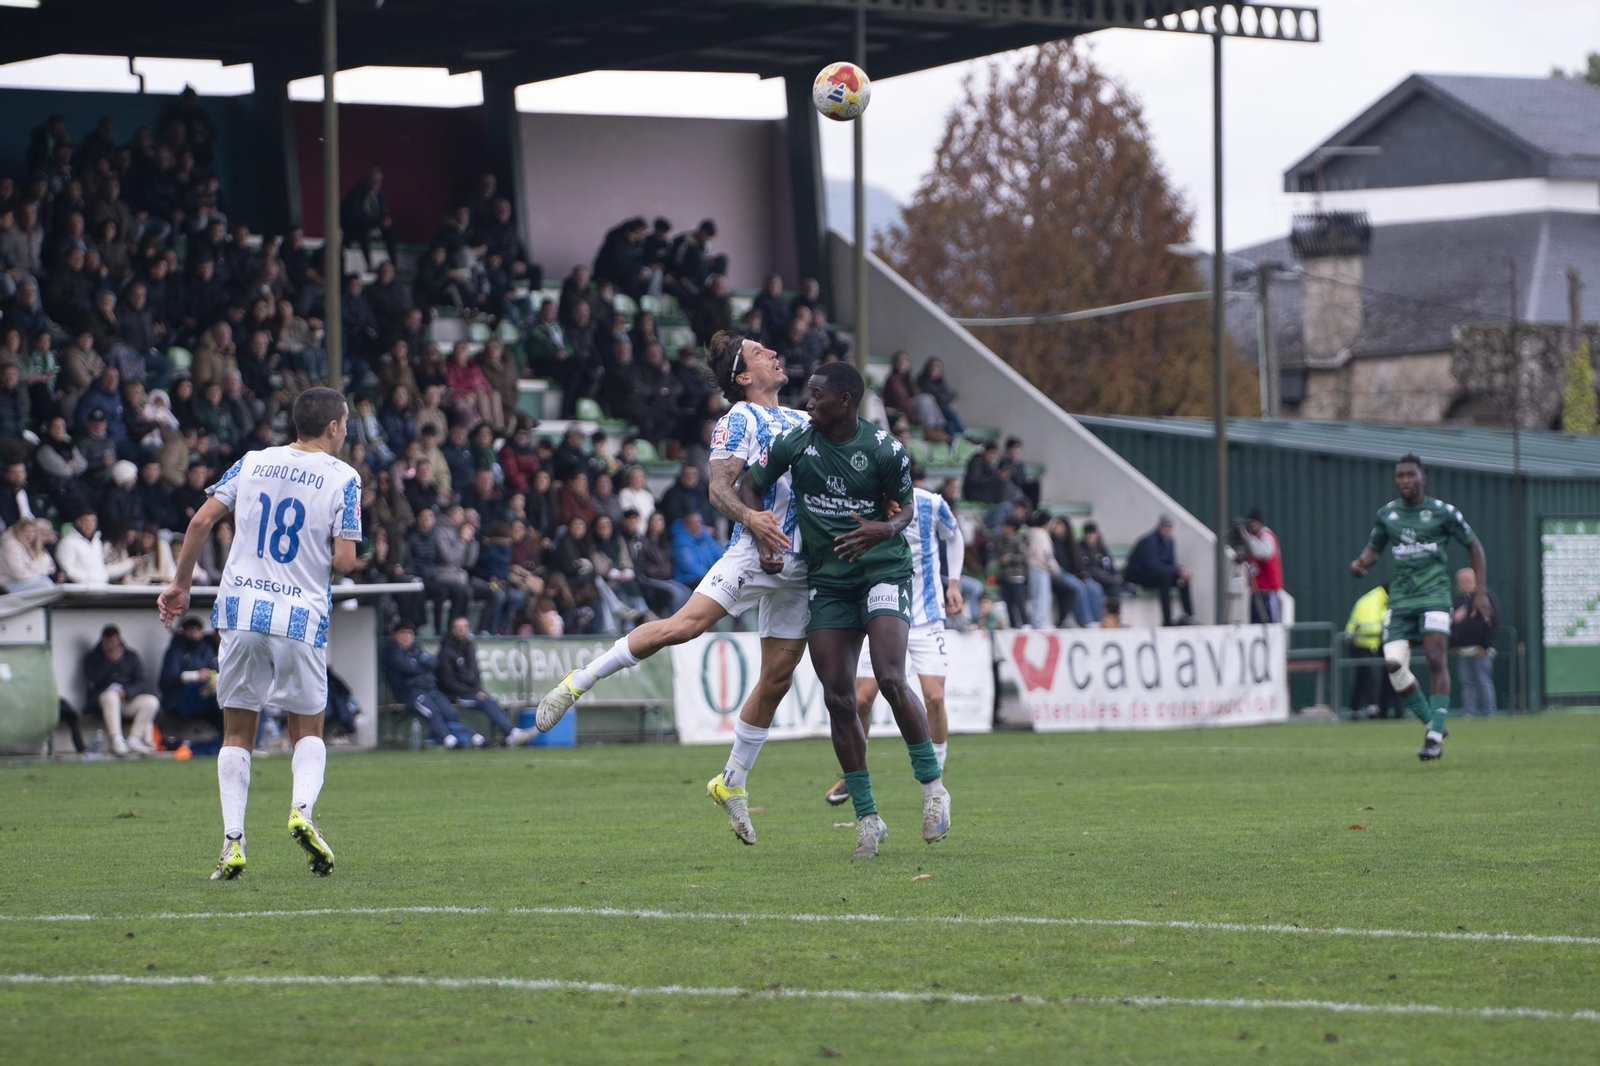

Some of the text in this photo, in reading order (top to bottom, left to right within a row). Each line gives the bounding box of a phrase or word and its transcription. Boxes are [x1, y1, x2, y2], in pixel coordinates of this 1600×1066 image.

[252, 464, 325, 490] PEDRO CAPÓ
[258, 491, 306, 564] 18
[234, 575, 302, 598] SASEGUR
[936, 636, 947, 655] 2
[1067, 626, 1273, 690] cadavid
